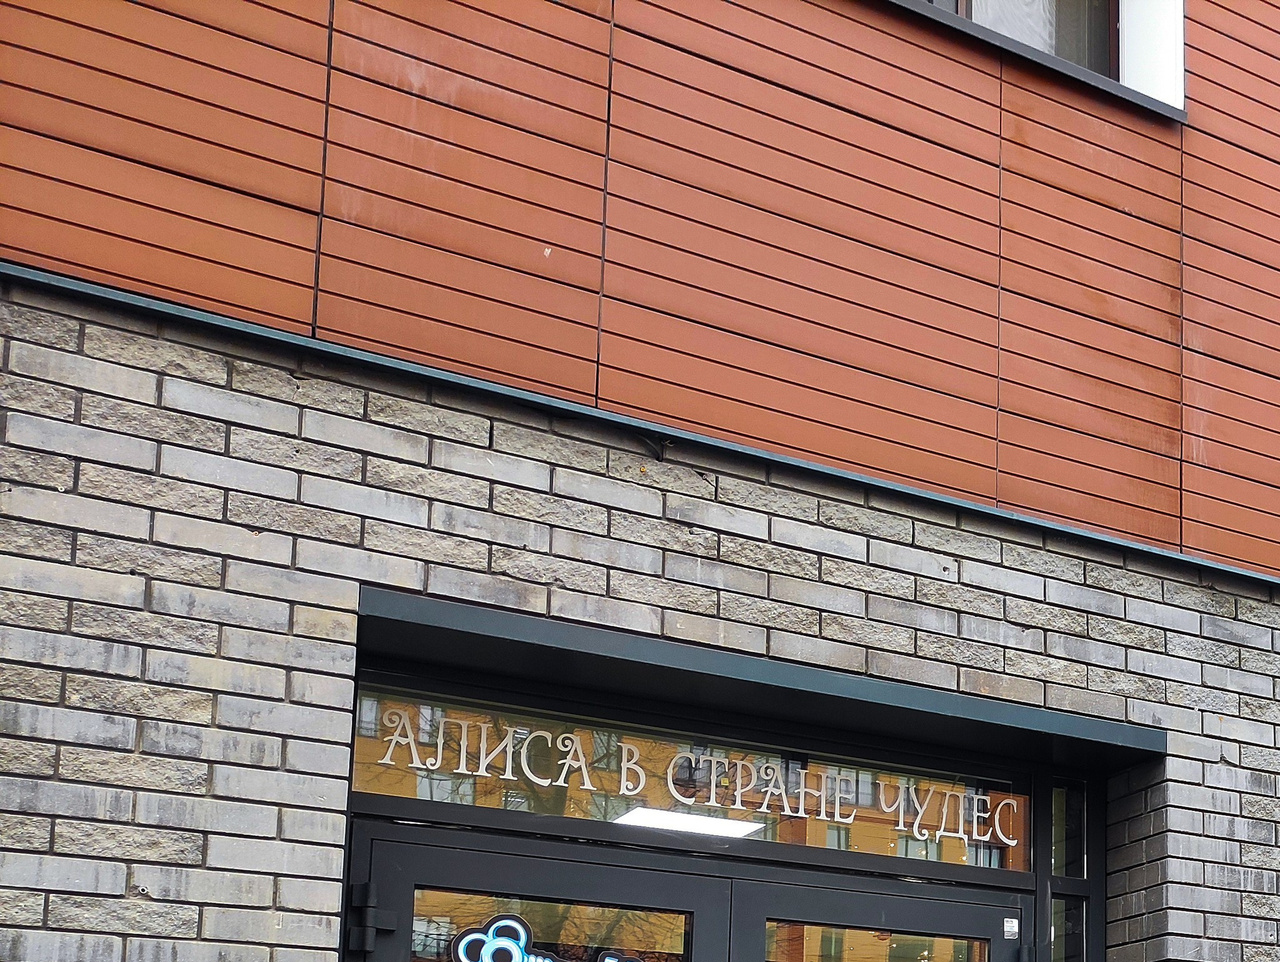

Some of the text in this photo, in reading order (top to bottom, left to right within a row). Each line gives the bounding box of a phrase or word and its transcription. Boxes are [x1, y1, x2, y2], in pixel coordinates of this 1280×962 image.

[377, 708, 1018, 848] АЛИСА В СТРАНЕ ЧУДЕС
